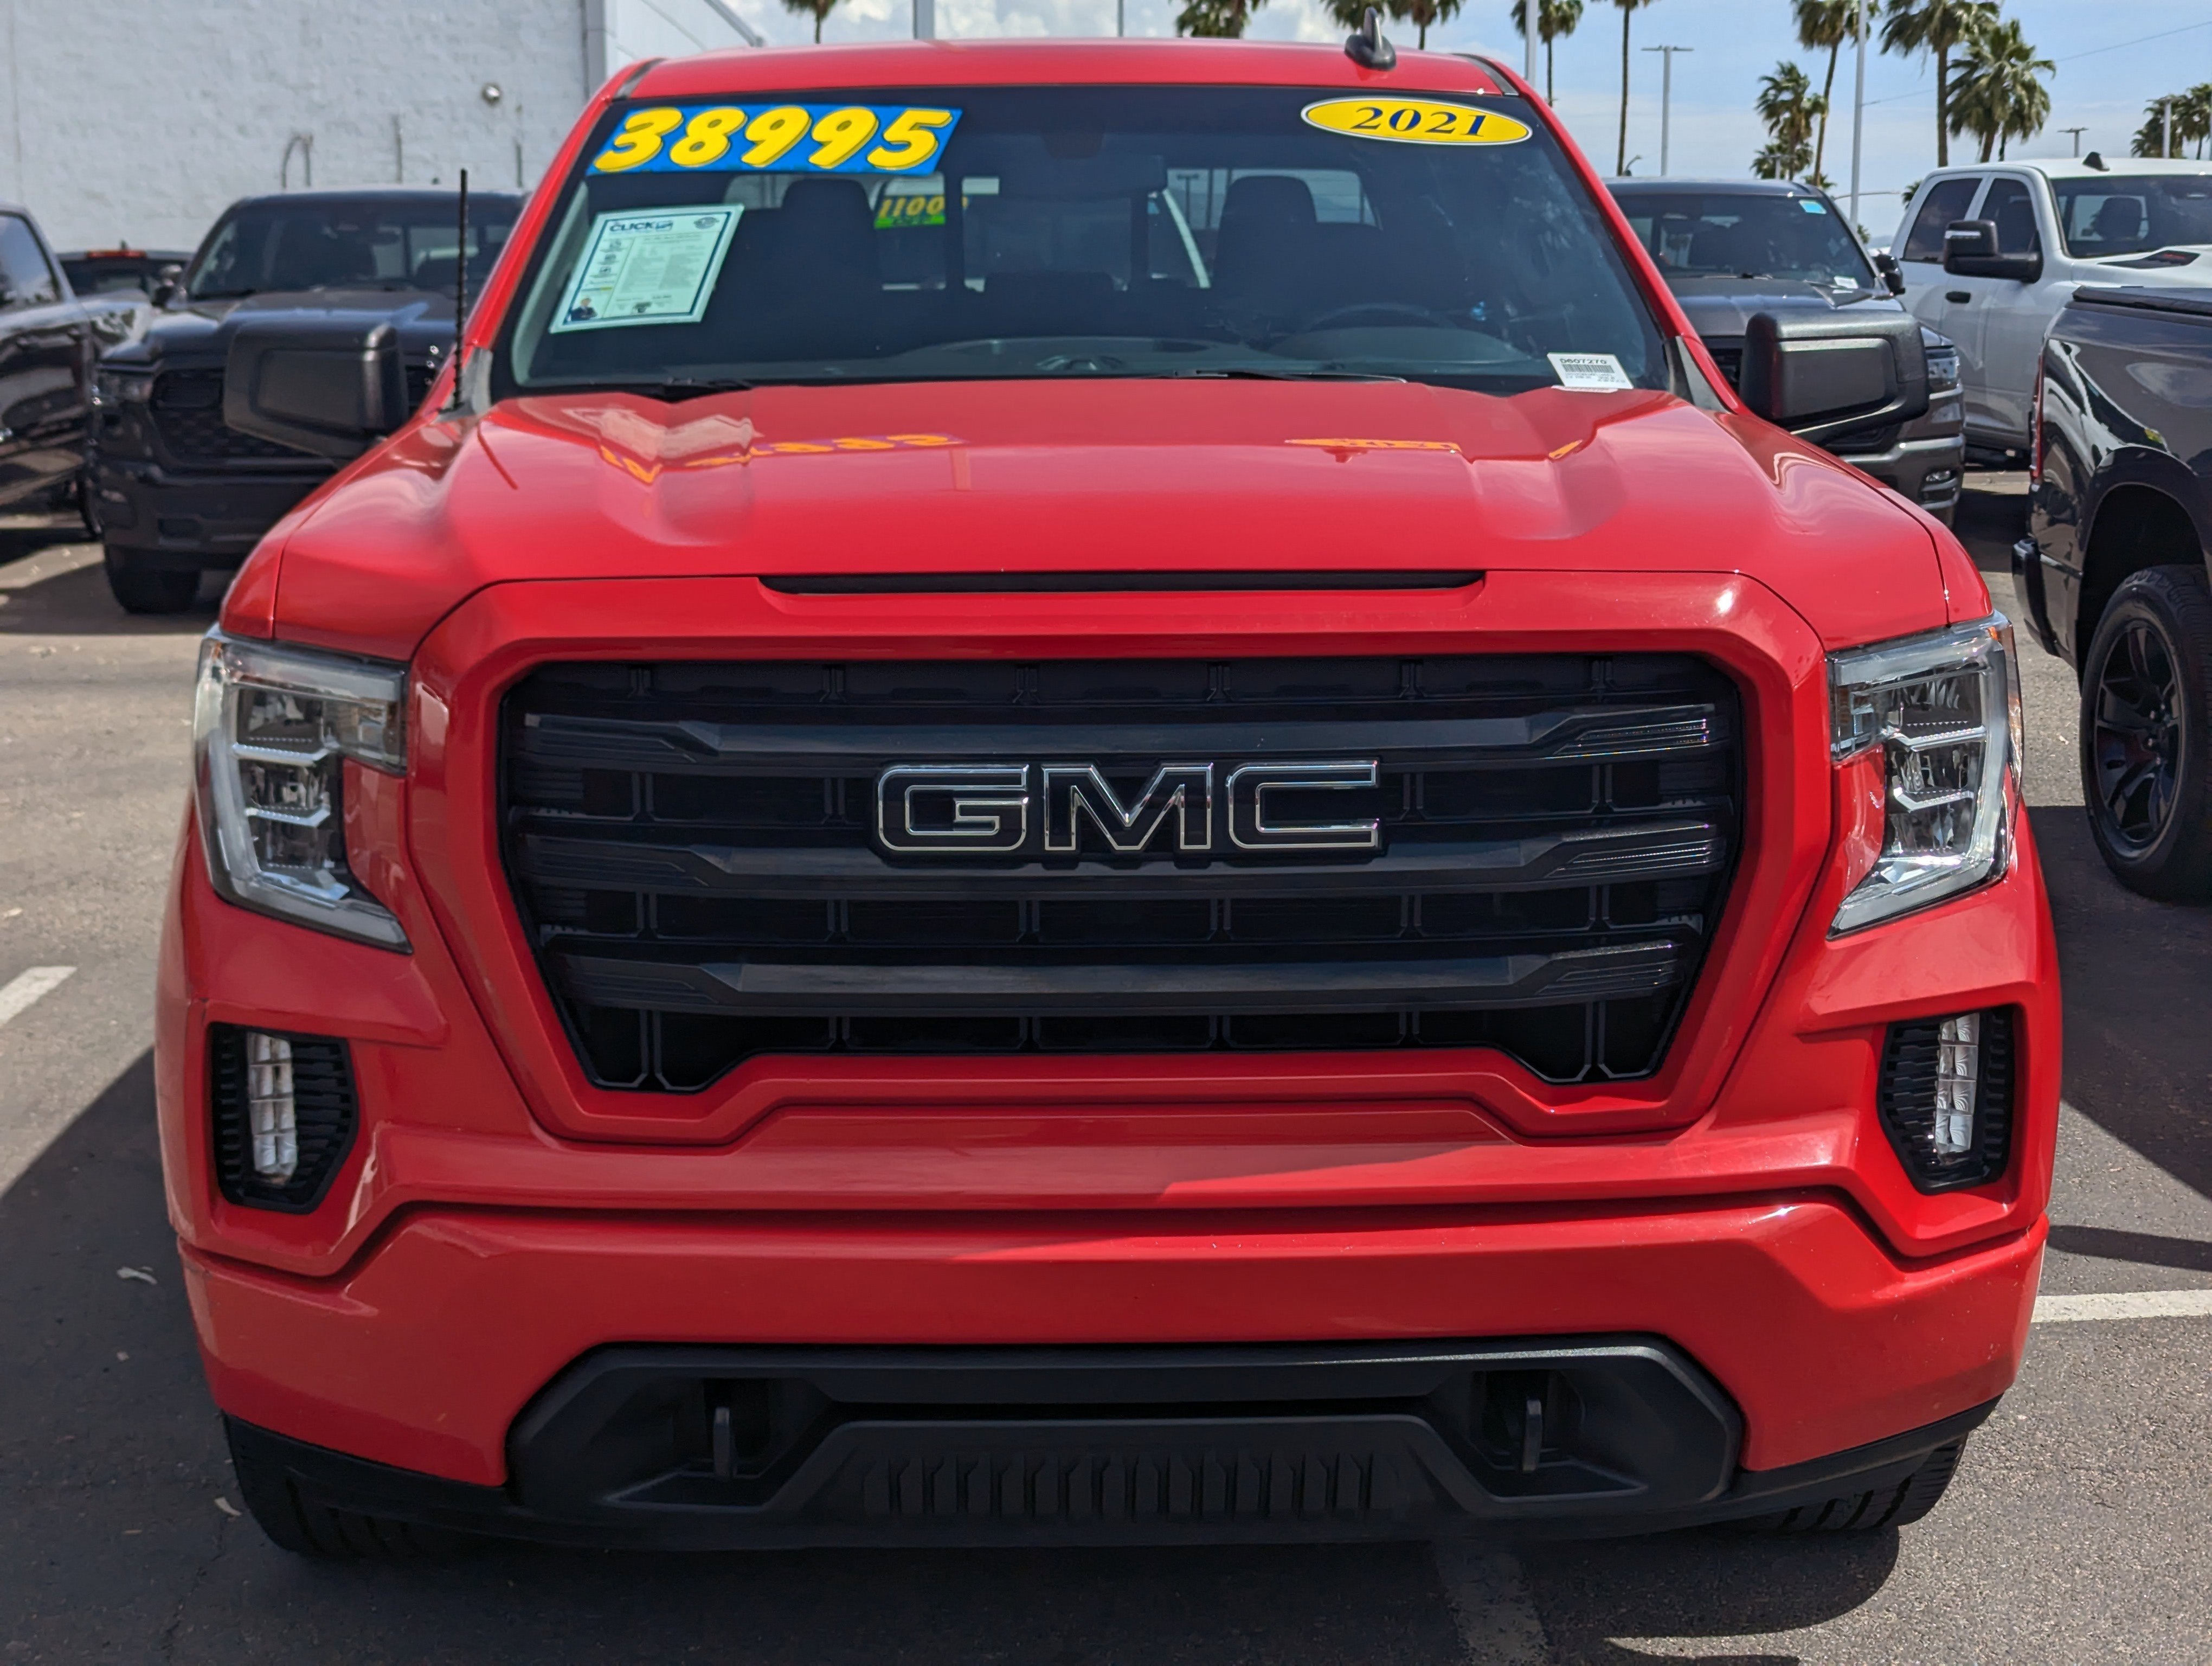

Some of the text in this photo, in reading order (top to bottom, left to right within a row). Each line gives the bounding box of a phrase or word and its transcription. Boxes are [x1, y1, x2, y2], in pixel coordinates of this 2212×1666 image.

[594, 107, 953, 171] 38995
[1350, 106, 1487, 137] 2021
[877, 762, 1380, 851] GMC
